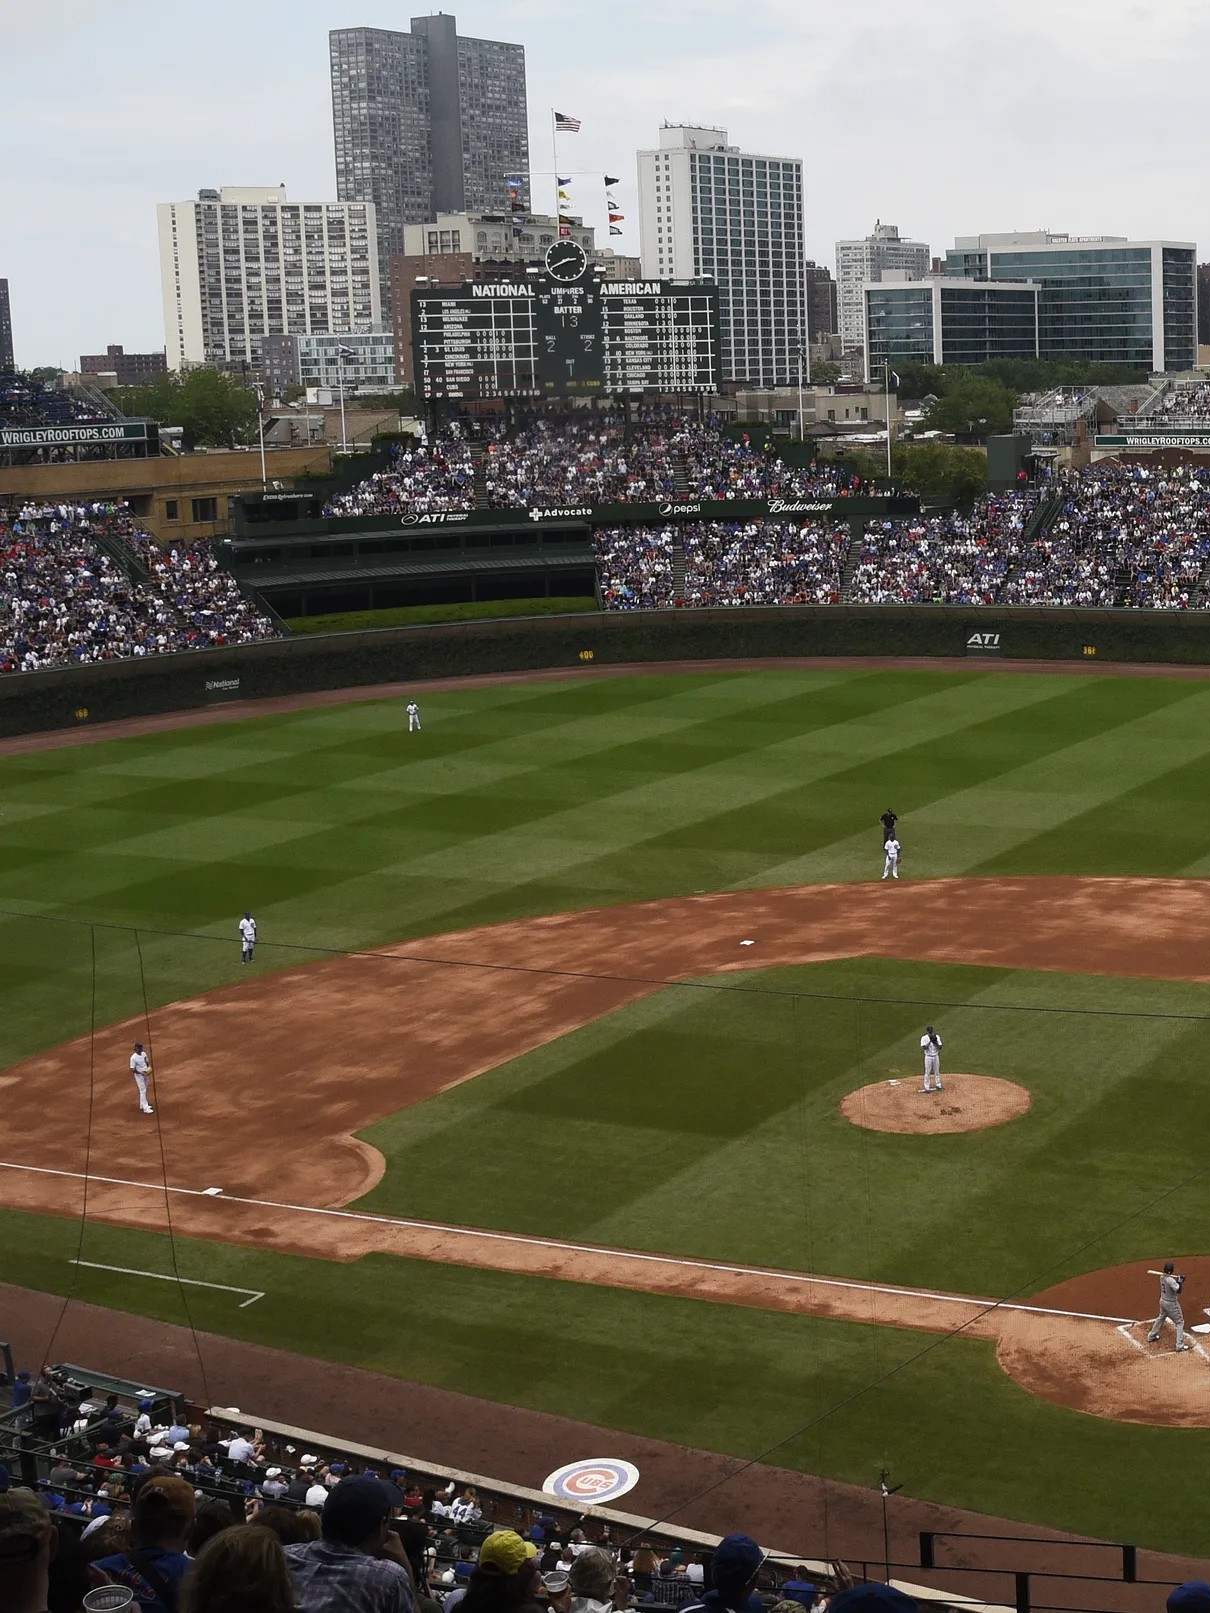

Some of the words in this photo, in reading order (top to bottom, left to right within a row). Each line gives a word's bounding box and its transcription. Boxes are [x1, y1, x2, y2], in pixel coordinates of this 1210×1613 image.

[473, 285, 535, 296] NATIONAL
[600, 283, 660, 294] AMERICAN
[562, 316, 578, 327] 13
[547, 341, 555, 352] 2
[584, 340, 592, 351] 2
[2, 427, 124, 444] WRIGLEYROOFTOPS.COM
[544, 507, 592, 517] Advocate
[673, 503, 701, 515] pepsi
[768, 500, 833, 513] Budweiser
[418, 513, 445, 523] ATI
[967, 634, 1000, 645] ATI
[579, 650, 593, 659] 400
[213, 678, 239, 688] National
[453, 1506, 467, 1520] 44
